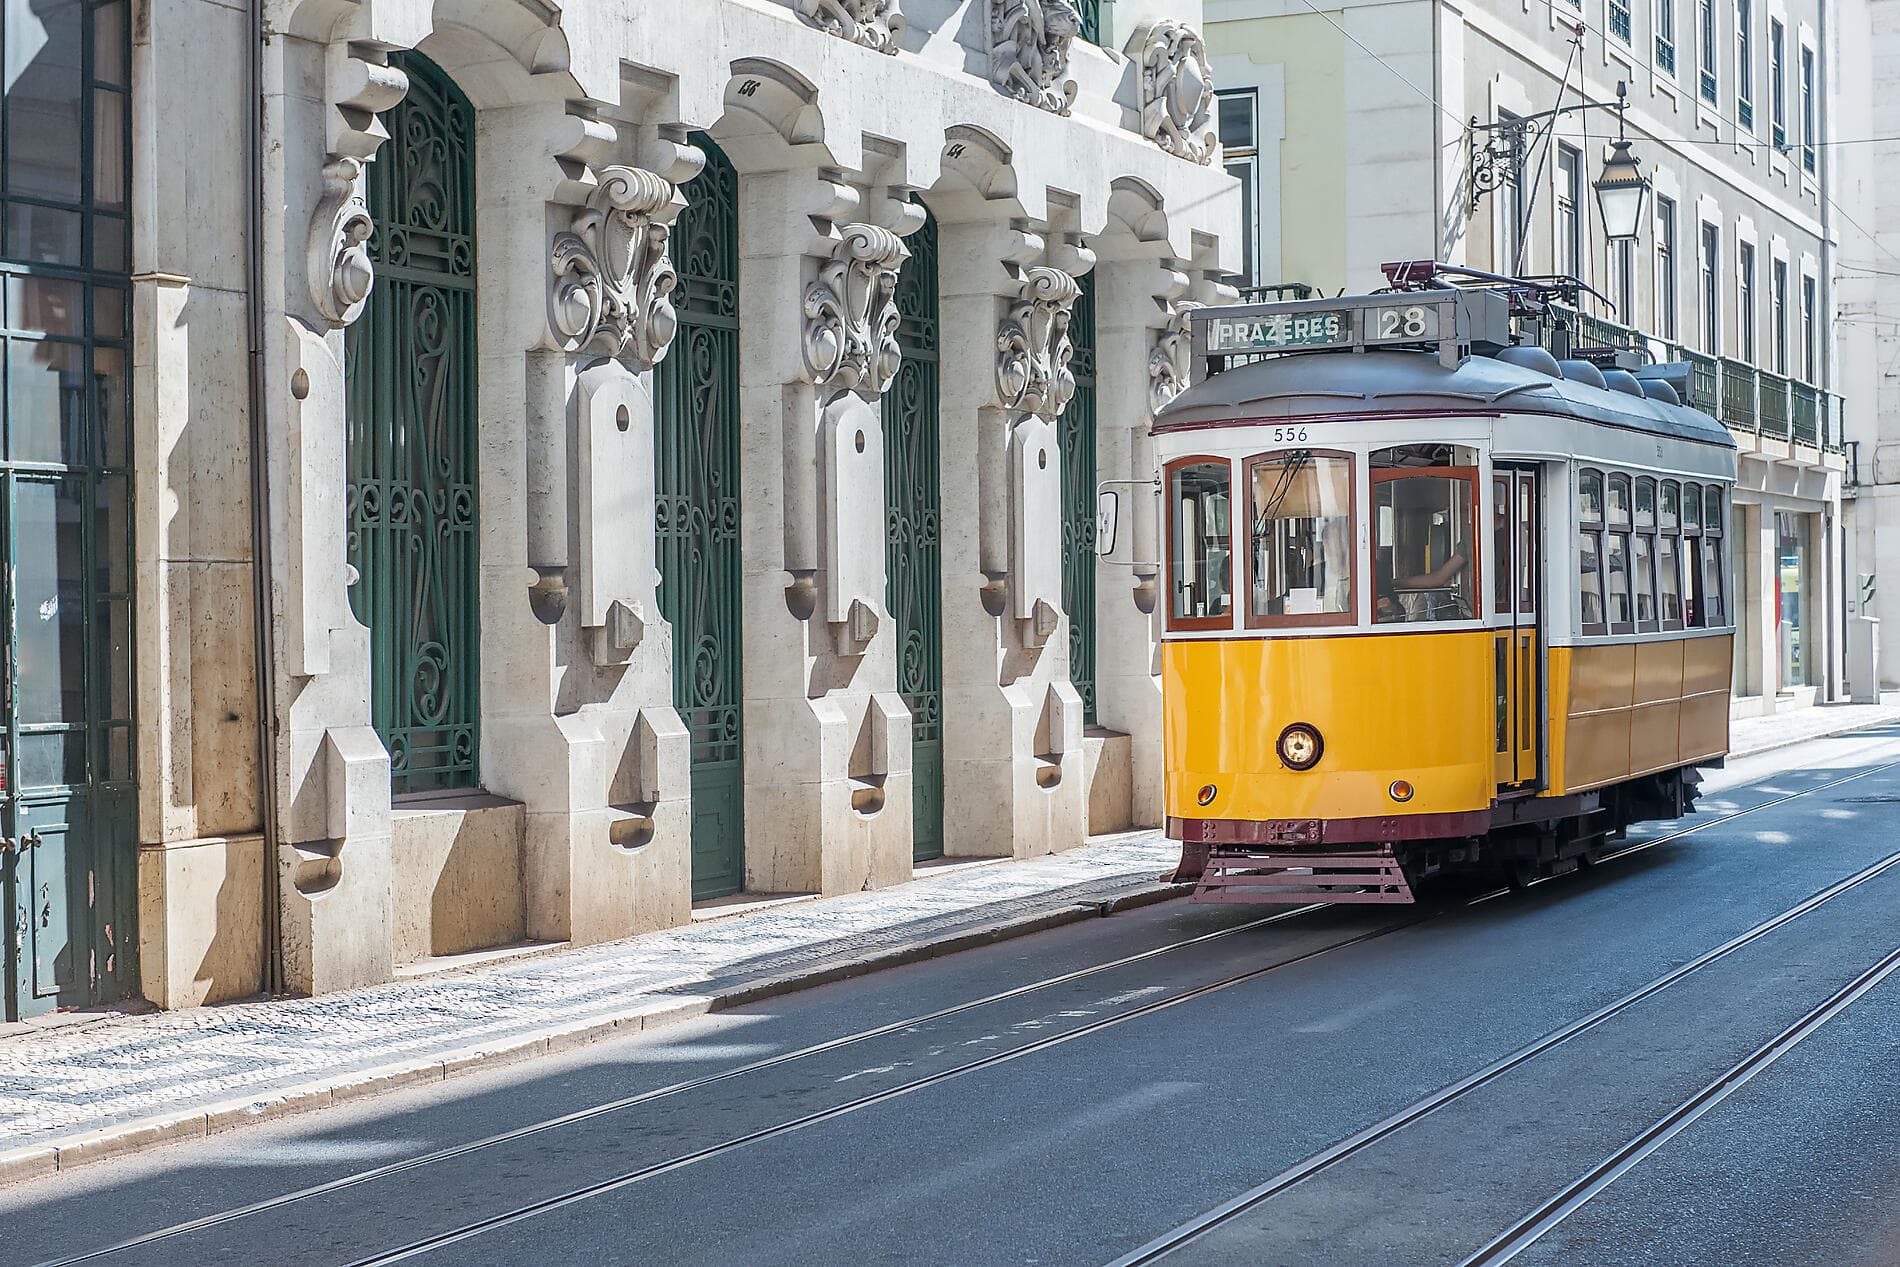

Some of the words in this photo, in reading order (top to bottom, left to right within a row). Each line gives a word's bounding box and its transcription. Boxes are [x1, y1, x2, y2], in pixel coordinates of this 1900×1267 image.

[737, 79, 761, 97] 136
[1219, 316, 1339, 343] PRAZERES
[1381, 307, 1426, 339] 28
[1274, 427, 1307, 441] 556
